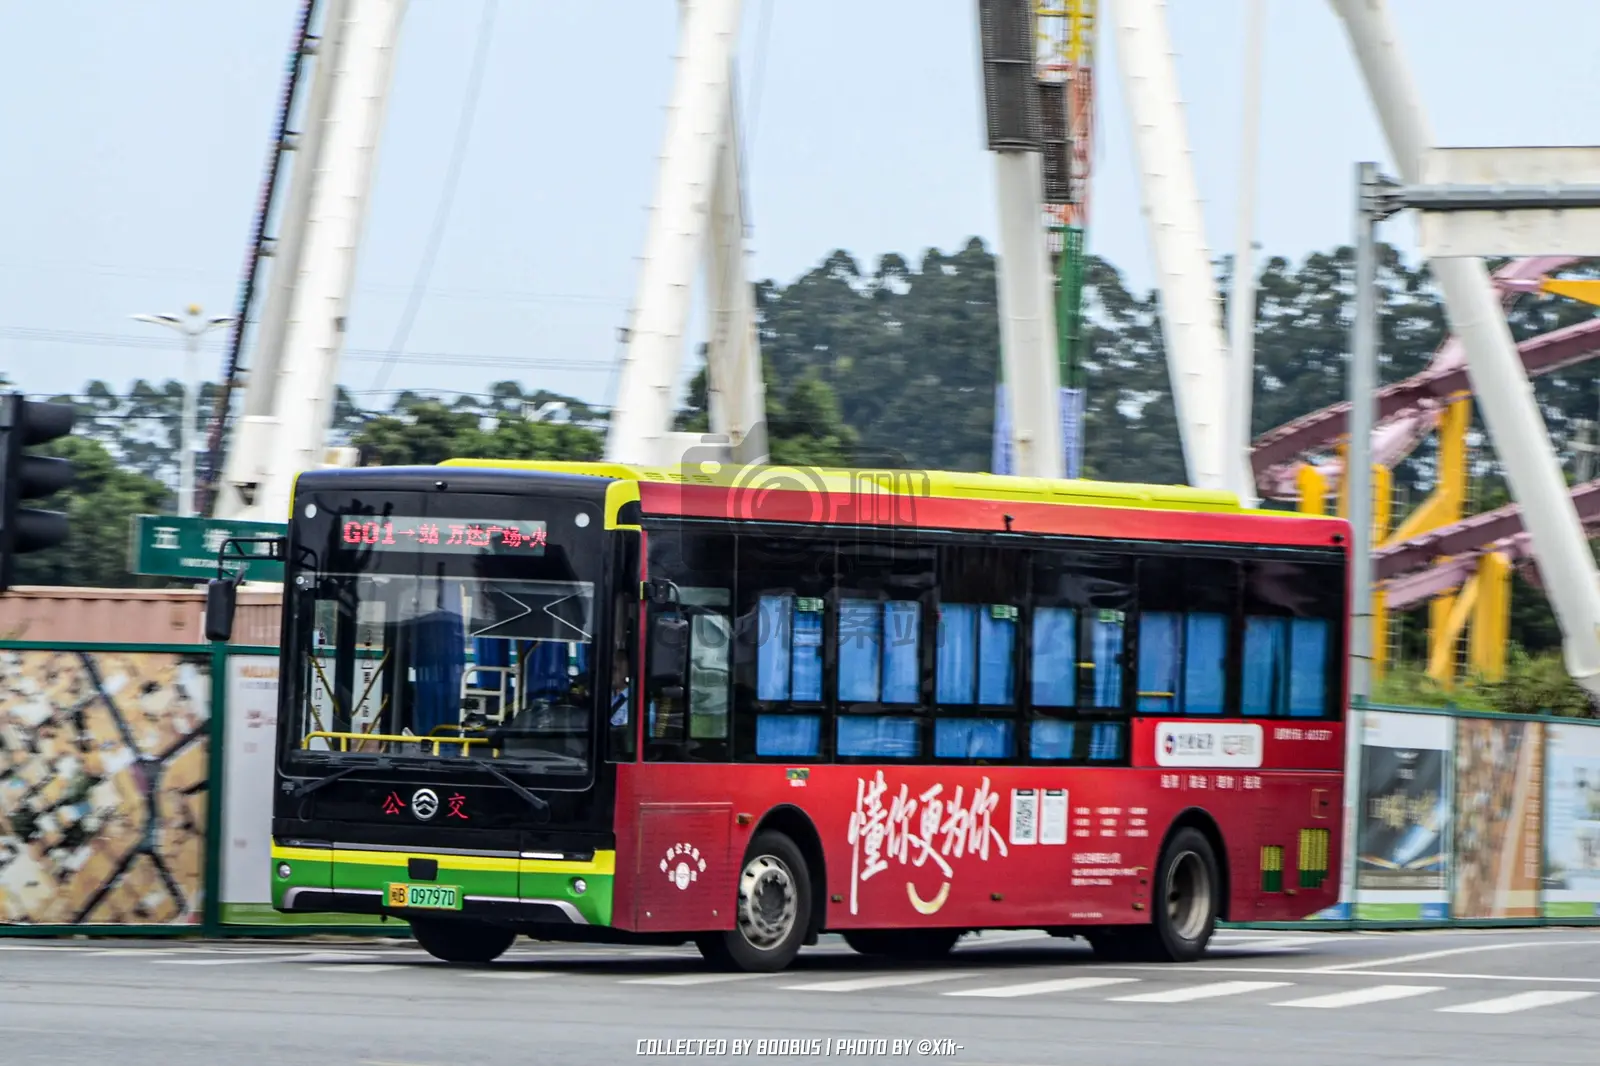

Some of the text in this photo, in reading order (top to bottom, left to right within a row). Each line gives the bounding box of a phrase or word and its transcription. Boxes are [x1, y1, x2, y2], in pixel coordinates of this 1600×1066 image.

[848, 769, 1008, 915] 懂你更为你
